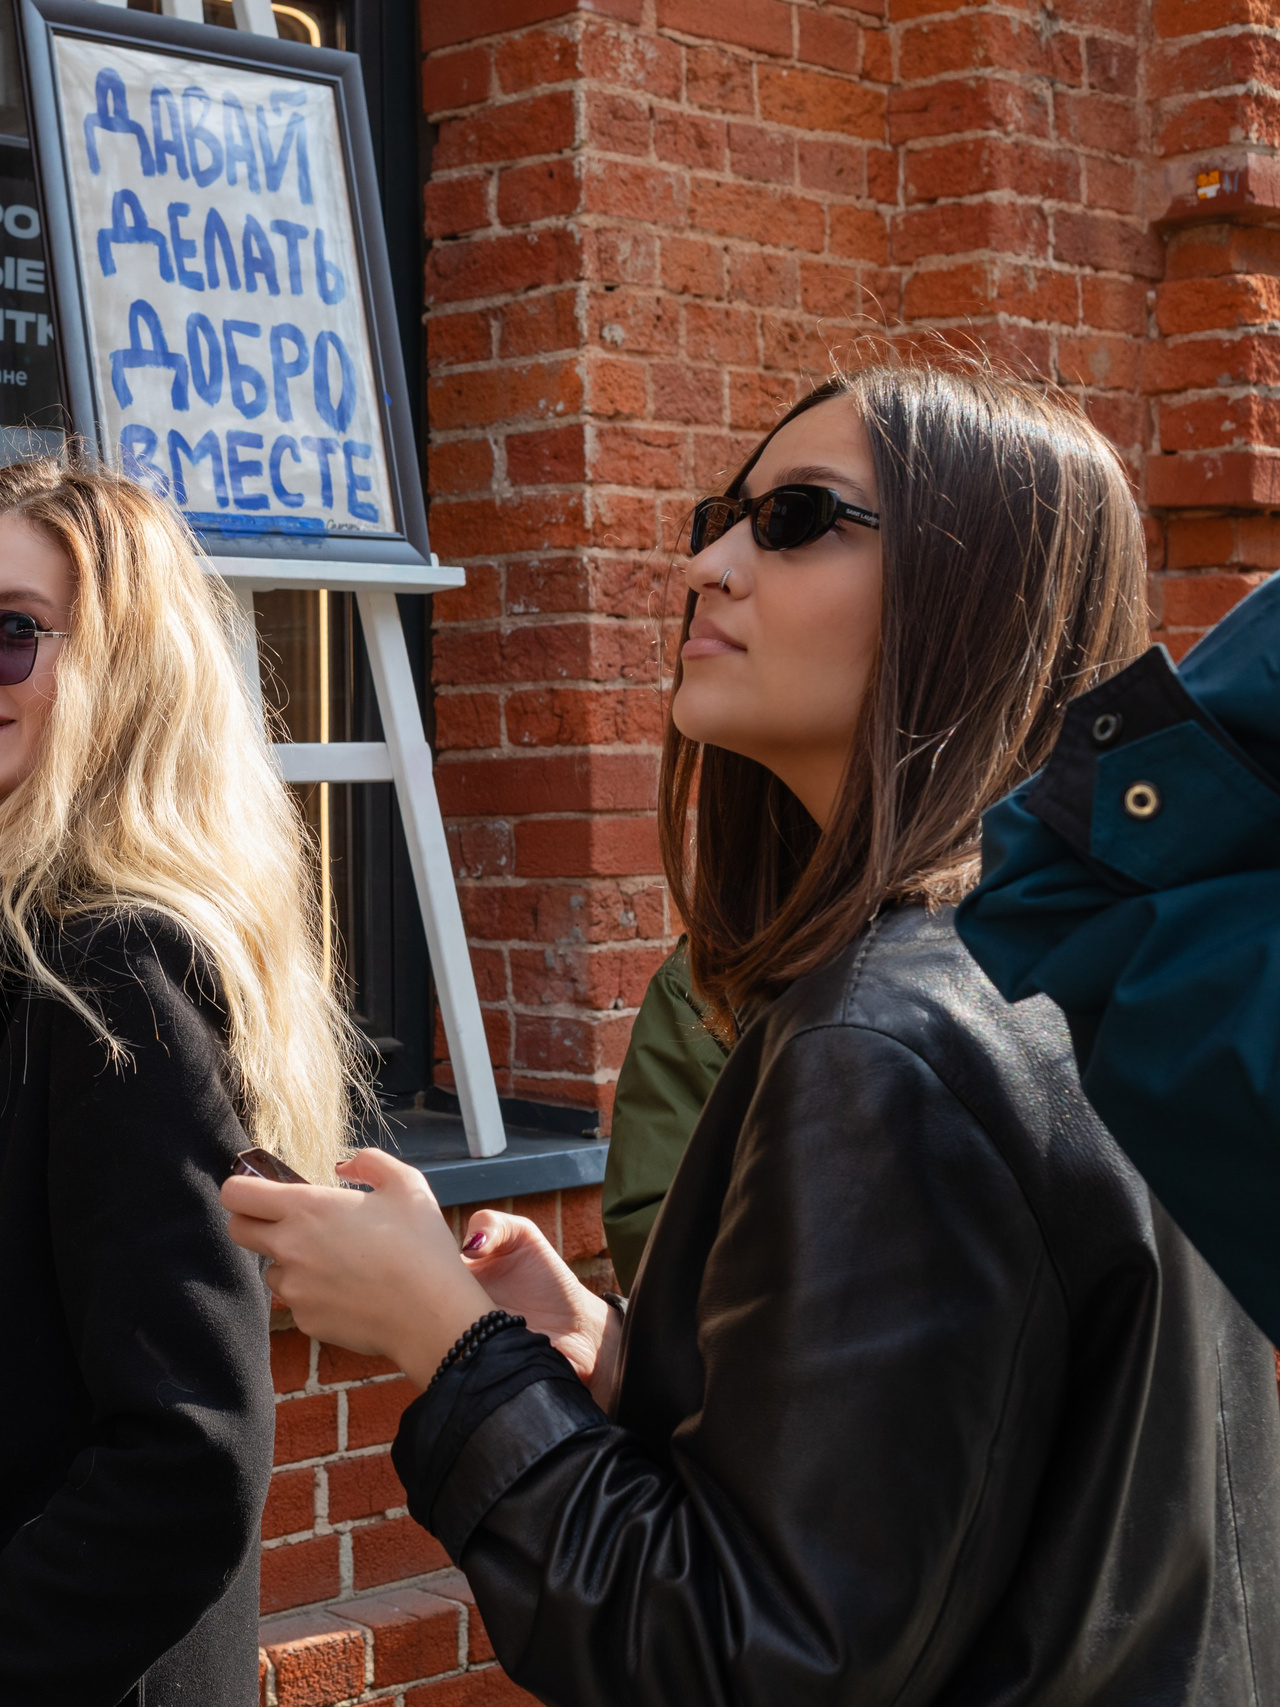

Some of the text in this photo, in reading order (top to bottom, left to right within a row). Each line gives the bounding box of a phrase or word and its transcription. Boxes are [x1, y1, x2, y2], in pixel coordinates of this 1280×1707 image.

[84, 67, 315, 205] ДАВАЙ
[97, 188, 347, 305] ДЕЛАТЬ
[109, 299, 359, 433] ДОБРО
[120, 424, 379, 522] ВМЕСТЕ
